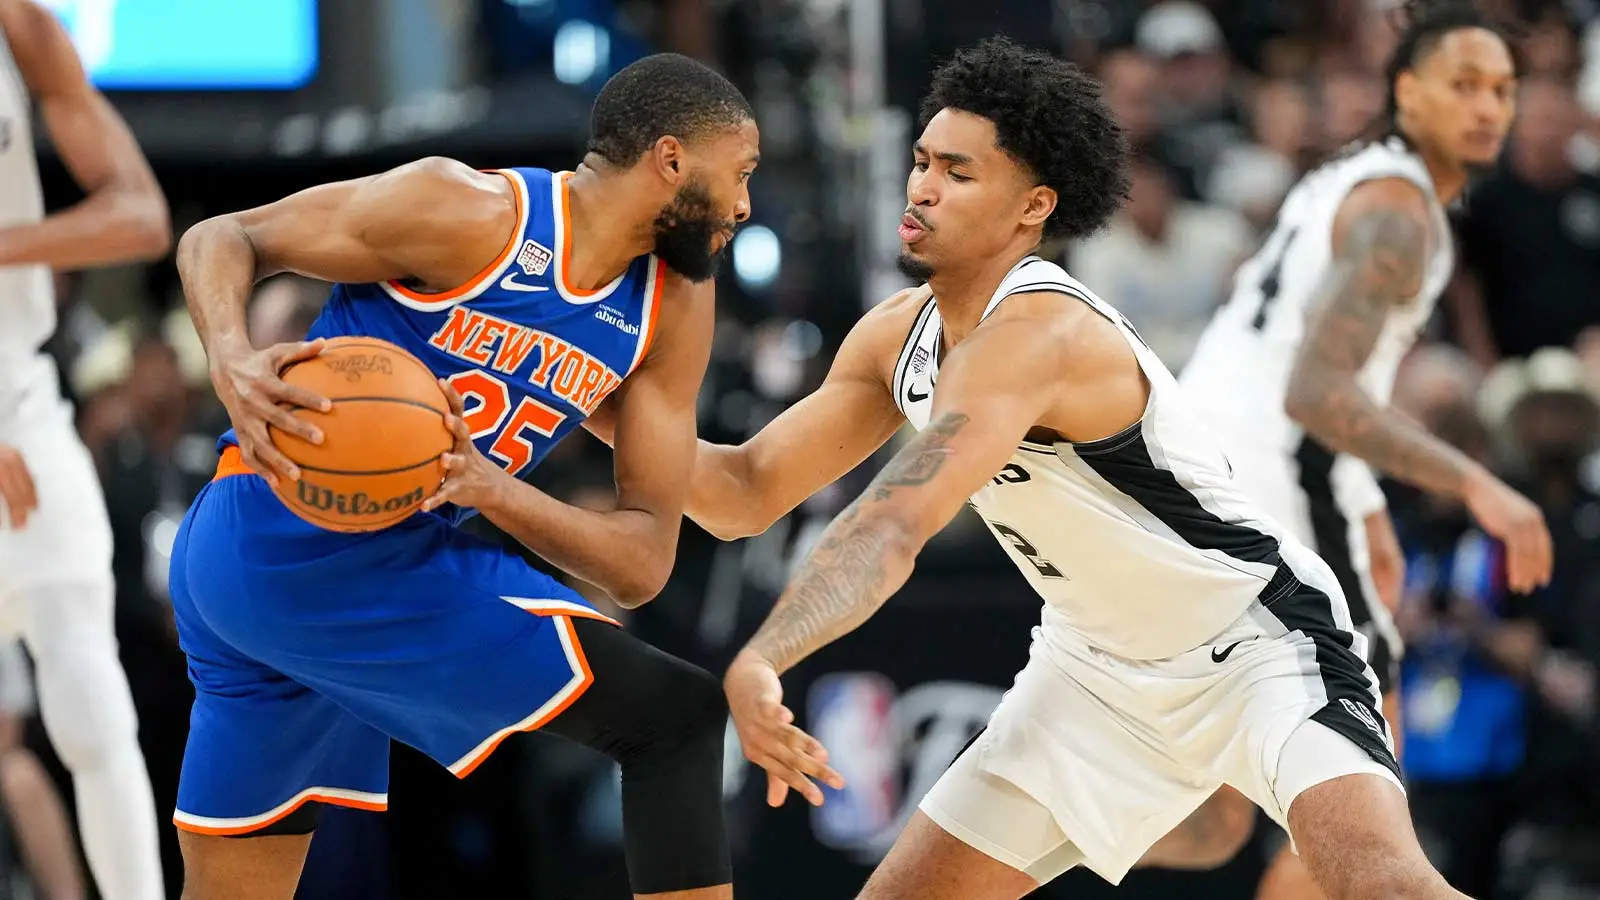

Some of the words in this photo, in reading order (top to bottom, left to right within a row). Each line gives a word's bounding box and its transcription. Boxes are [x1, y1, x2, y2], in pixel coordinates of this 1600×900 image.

[520, 255, 544, 273] 250
[526, 244, 549, 261] USA
[595, 311, 617, 325] abu
[616, 318, 640, 336] dhabi
[428, 305, 541, 376] NEW
[528, 335, 623, 418] YORK
[445, 369, 568, 477] 25
[297, 479, 424, 516] Wilson
[987, 519, 1070, 581] 2
